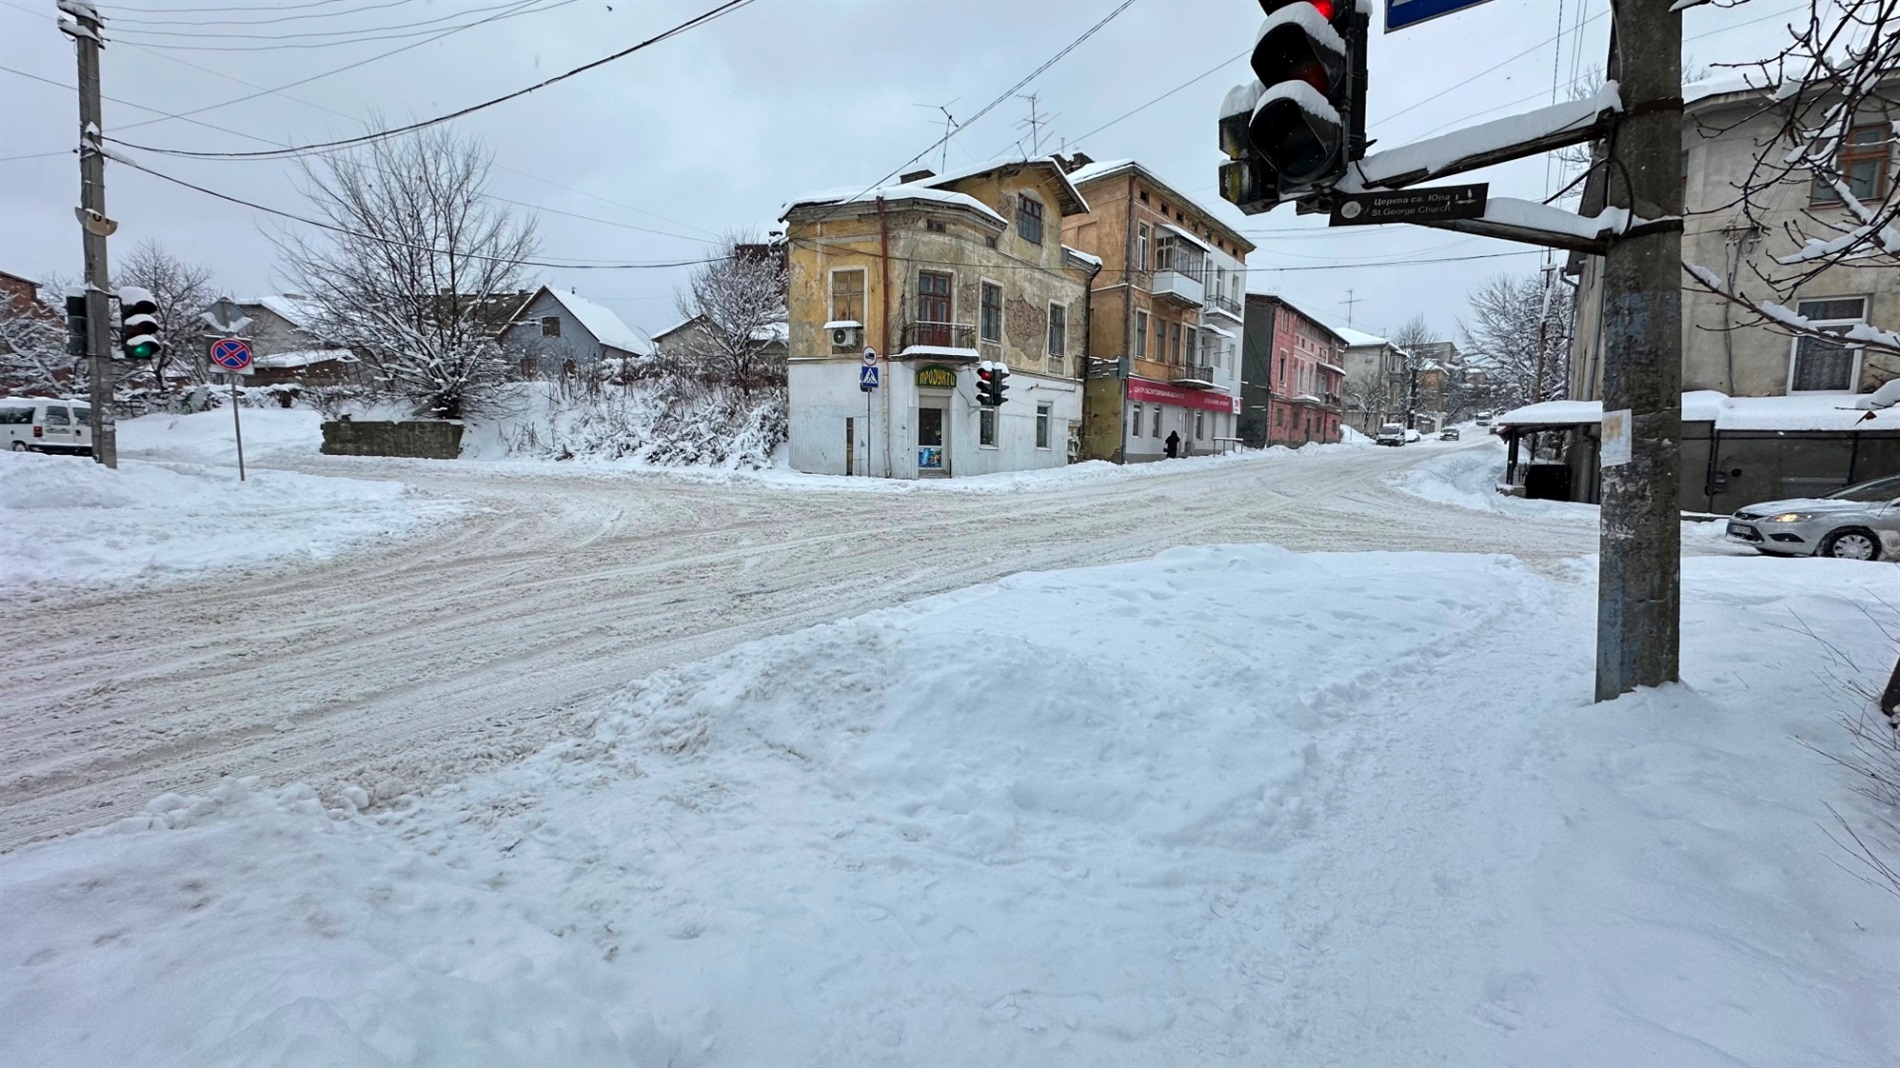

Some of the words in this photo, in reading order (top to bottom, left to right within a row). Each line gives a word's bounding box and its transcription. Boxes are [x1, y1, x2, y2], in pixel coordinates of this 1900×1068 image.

[1373, 197, 1409, 206] Церква
[1428, 193, 1451, 202] Юра
[1417, 204, 1451, 214] Church
